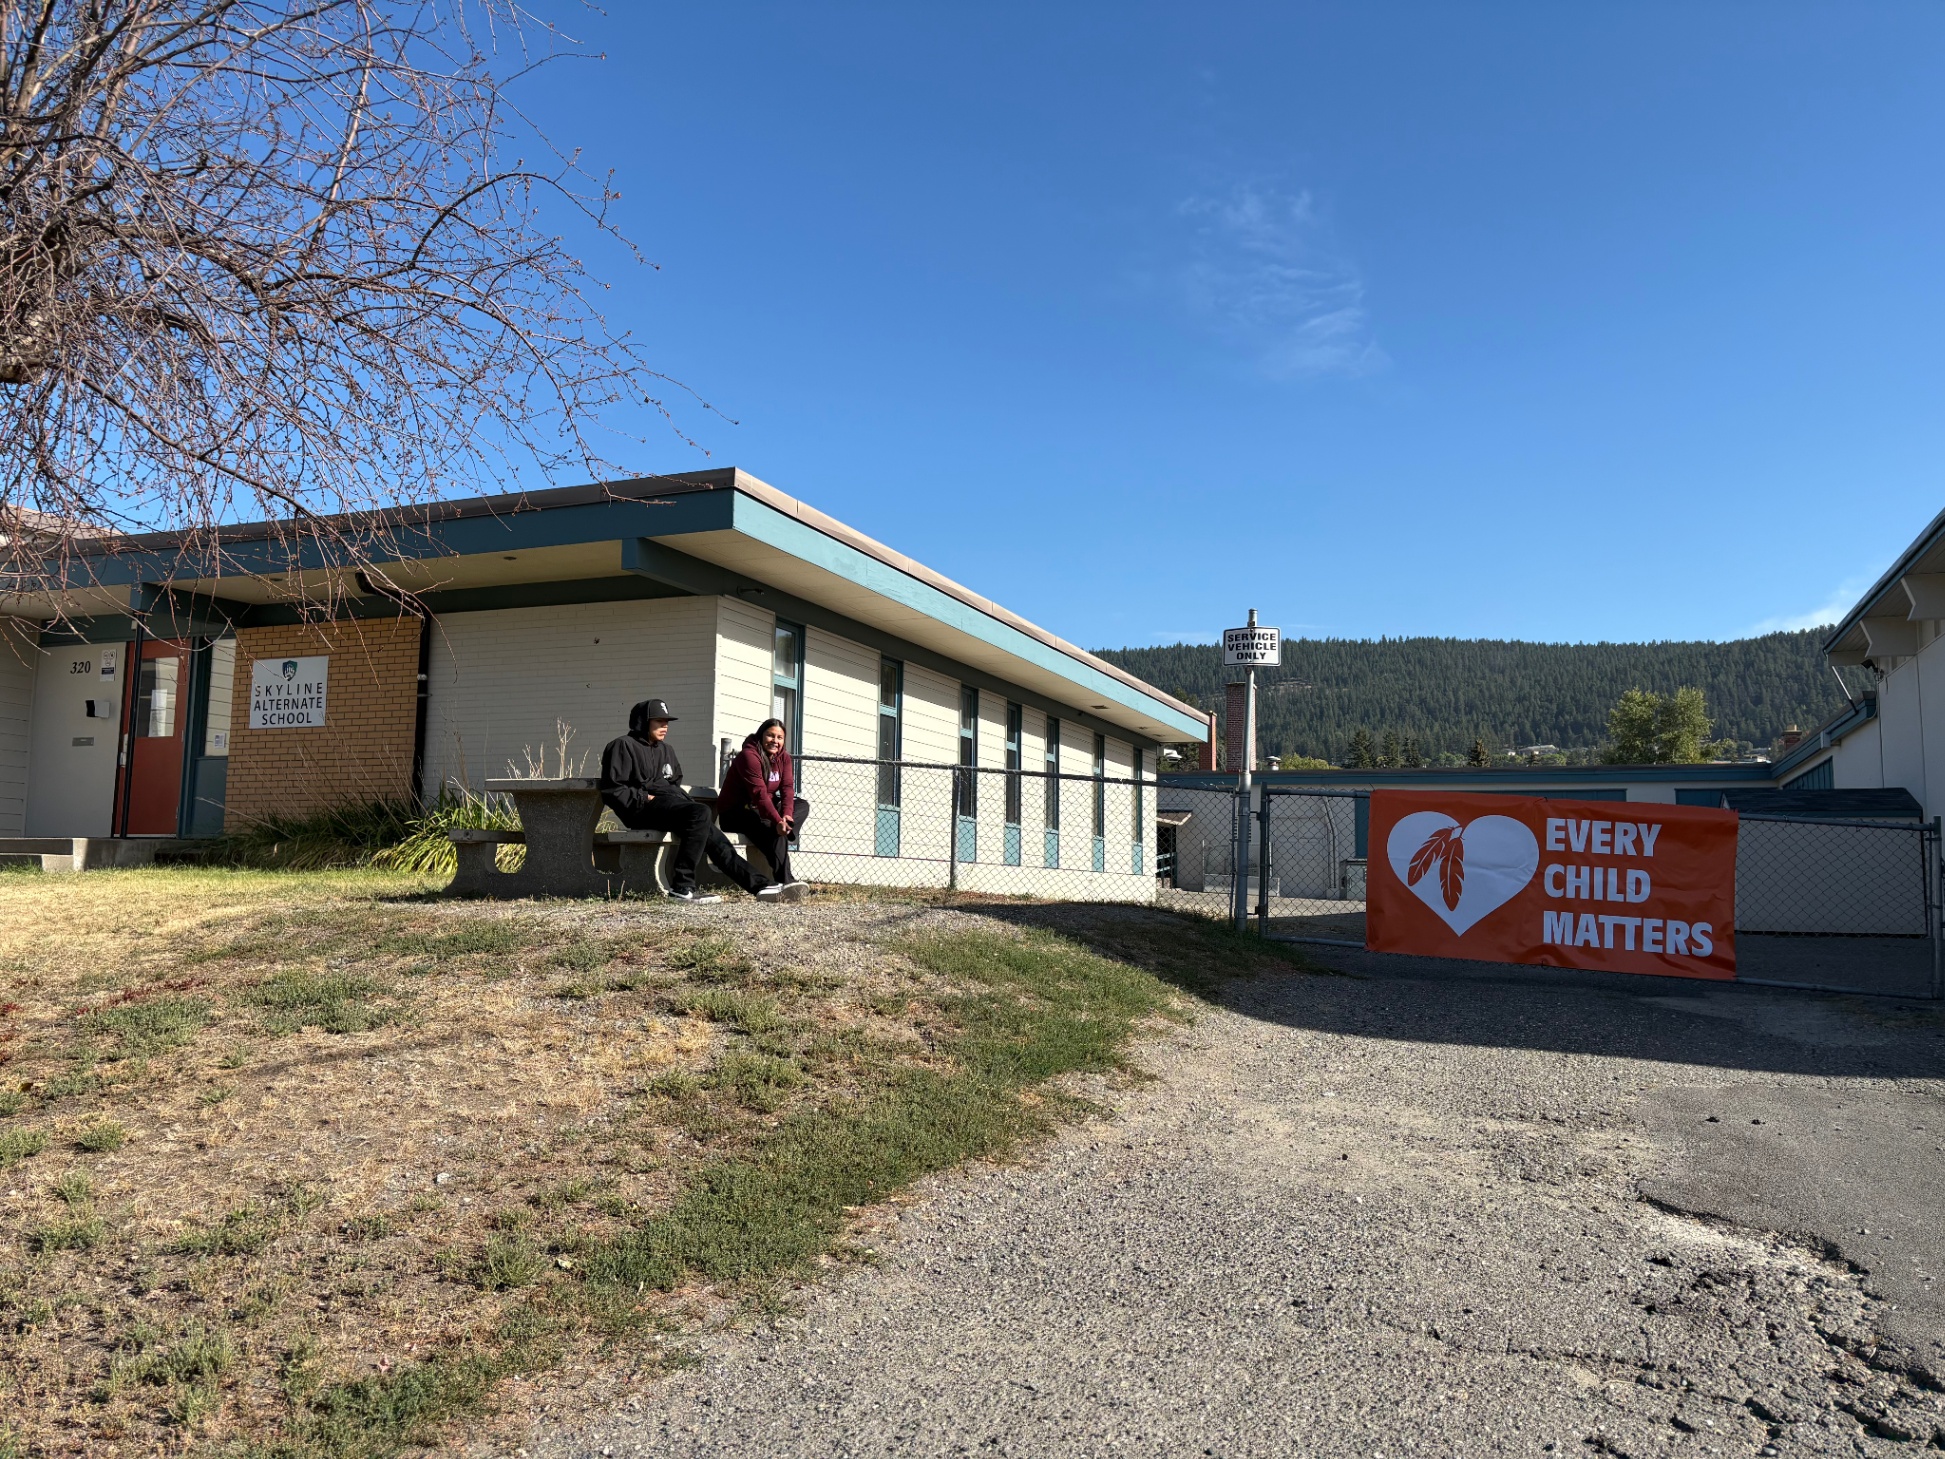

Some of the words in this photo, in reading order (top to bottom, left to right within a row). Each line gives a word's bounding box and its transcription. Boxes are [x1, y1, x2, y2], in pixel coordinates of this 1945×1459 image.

[1228, 633, 1276, 642] SERVICE
[1228, 642, 1276, 651] VEHICLE
[1237, 652, 1266, 660] ONLY
[70, 661, 91, 674] 320
[255, 683, 323, 697] SKYLINE
[254, 697, 323, 711] ALTERNATE
[262, 712, 312, 725] SCHOOL
[1546, 818, 1662, 857] EVERY
[1544, 863, 1651, 903] CHILD
[1543, 910, 1713, 957] MATTERS
